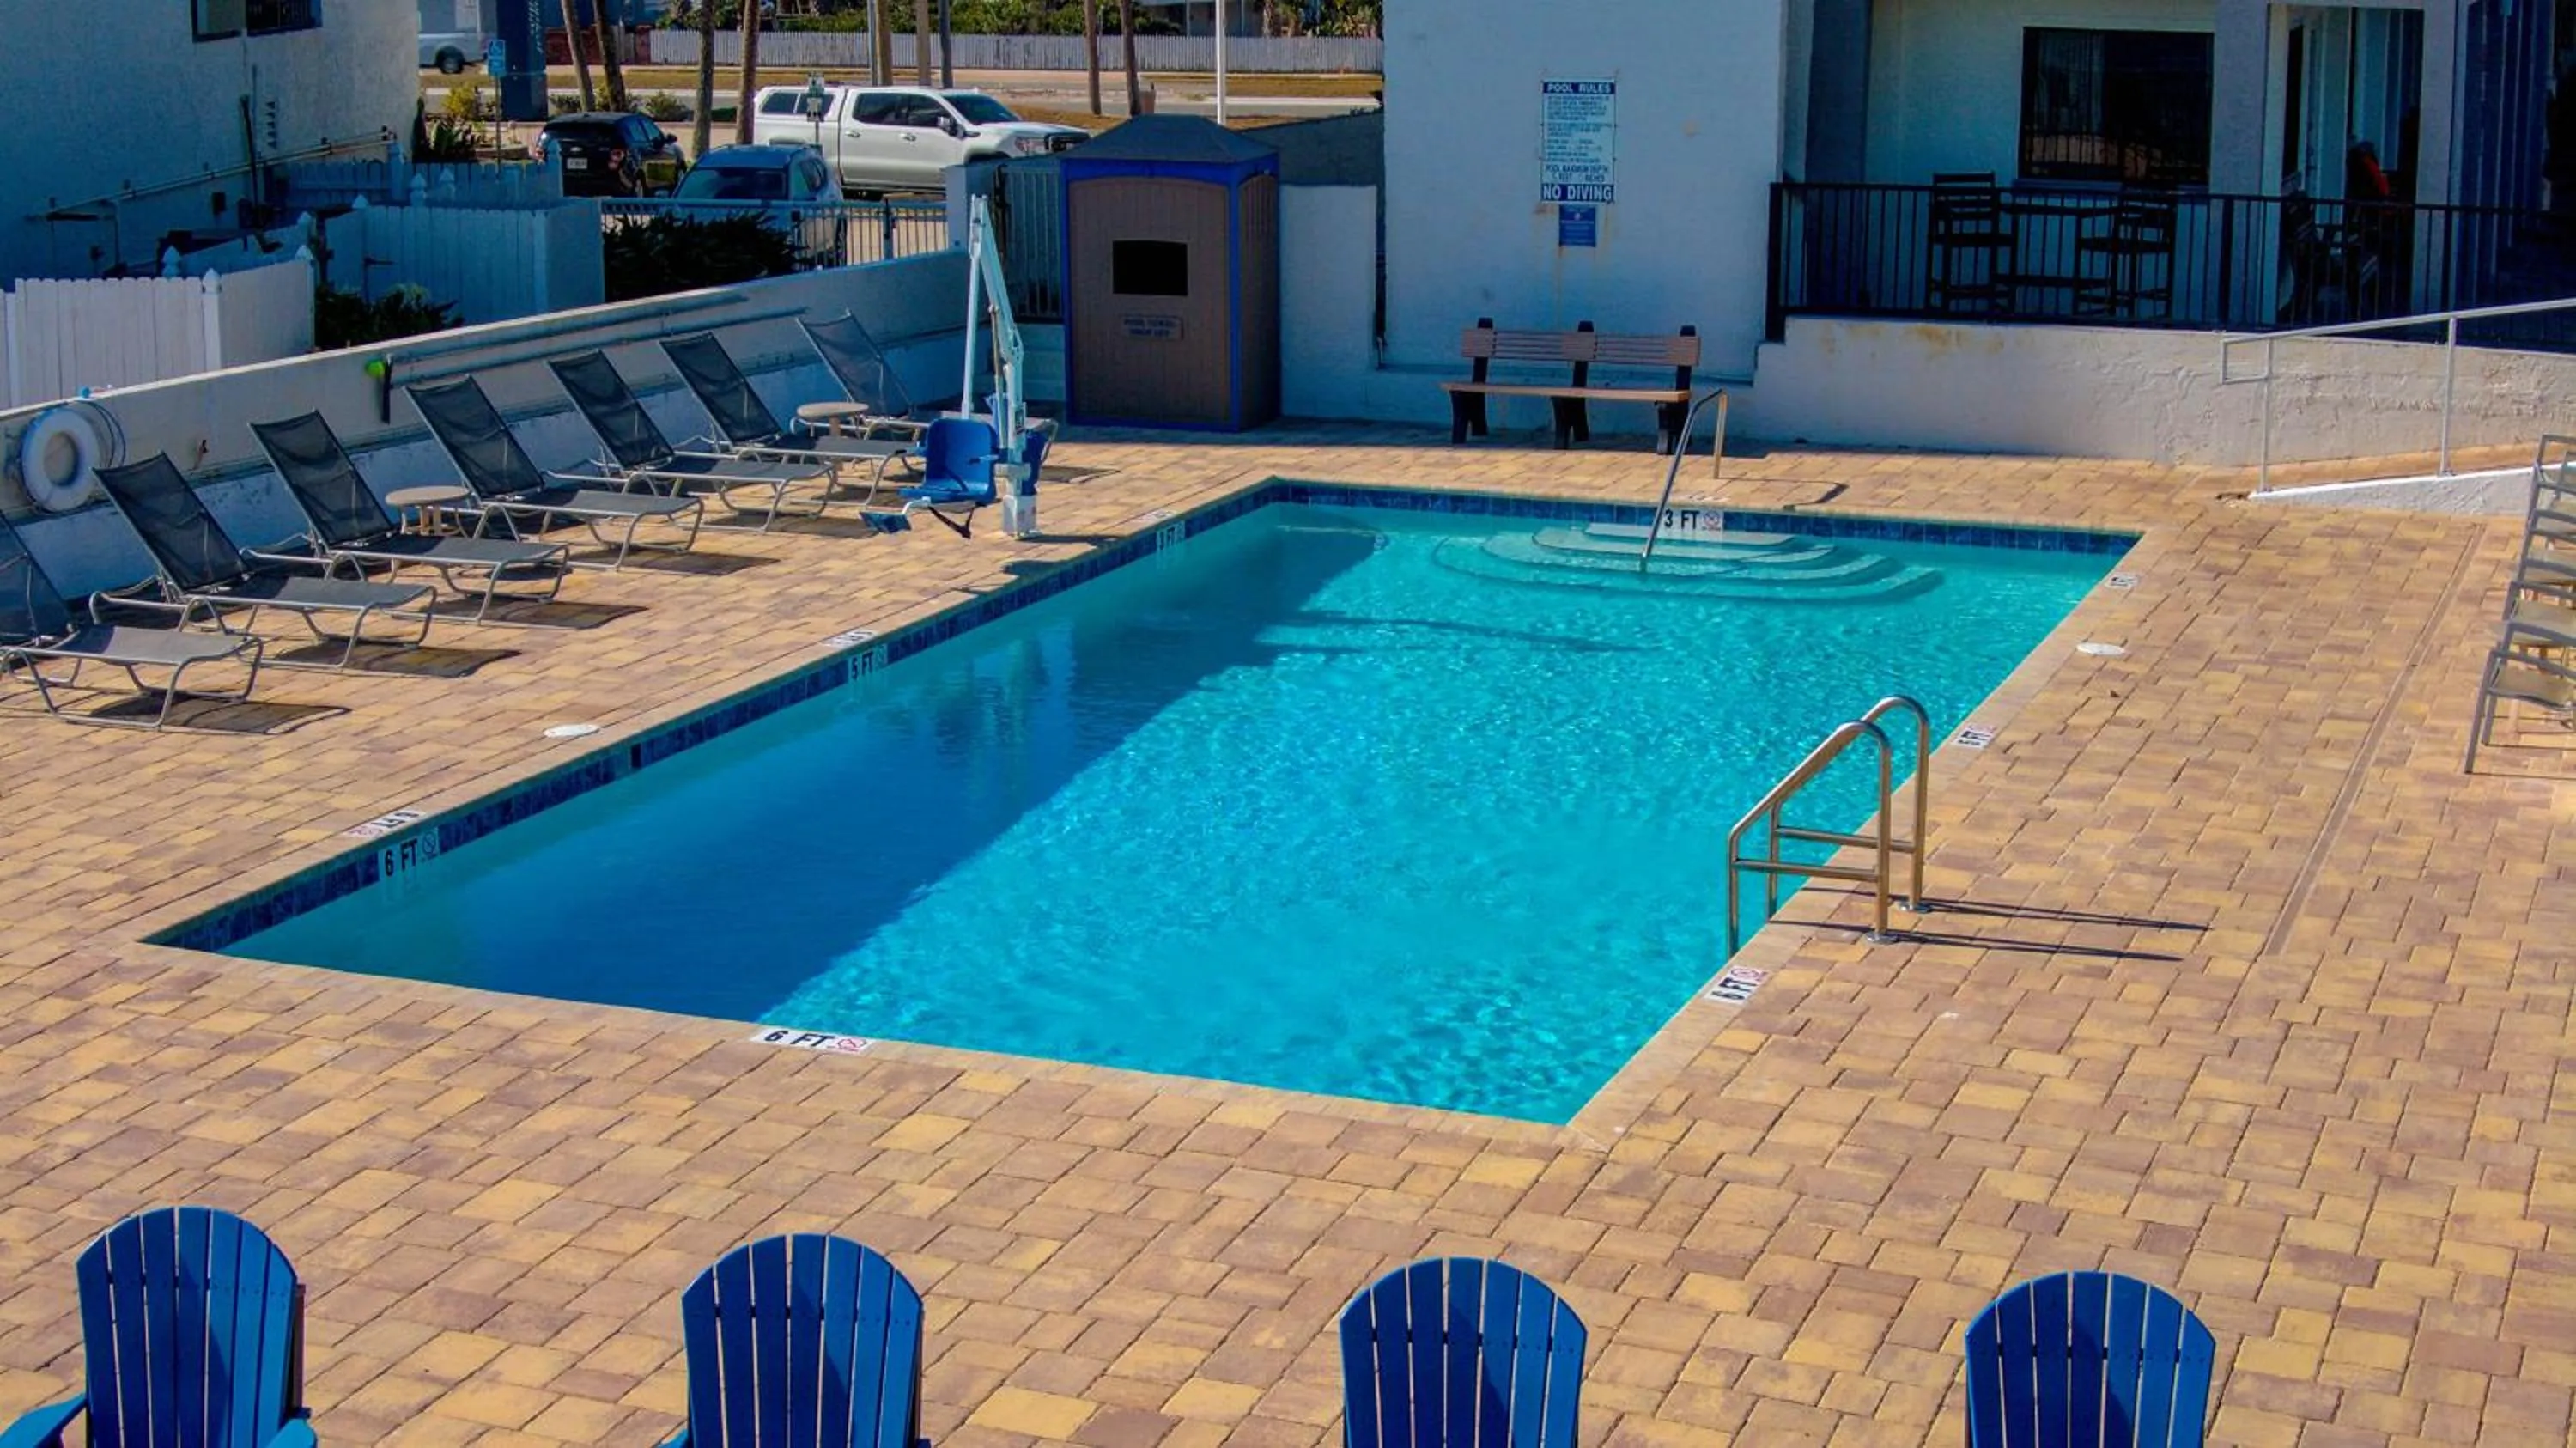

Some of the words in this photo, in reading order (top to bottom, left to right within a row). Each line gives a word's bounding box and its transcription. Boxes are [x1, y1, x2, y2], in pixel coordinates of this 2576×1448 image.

[1548, 83, 1573, 94] POOL
[1579, 83, 1611, 94] RULES
[1543, 185, 1562, 200] NO
[1567, 185, 1612, 201] DIVING
[1664, 508, 1674, 528] 3
[1680, 509, 1700, 530] FT
[861, 649, 874, 677] FT
[385, 849, 394, 877] 6
[400, 837, 418, 873] FT
[1718, 976, 1758, 993] FT
[764, 1030, 789, 1042] 6
[789, 1033, 835, 1047] FT
